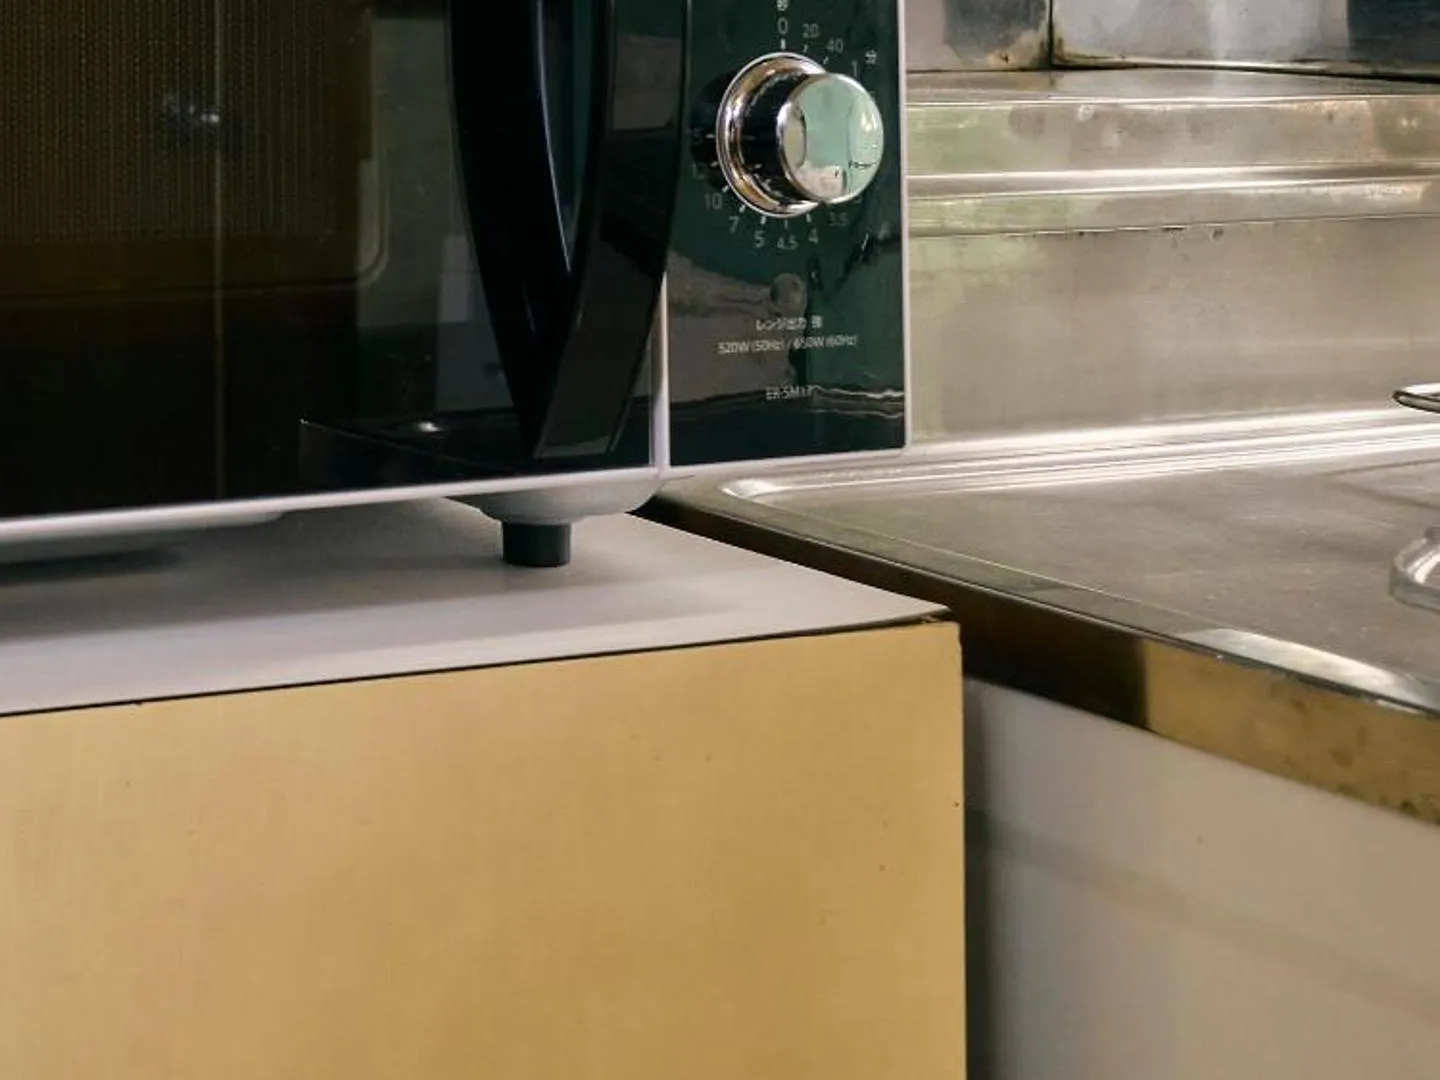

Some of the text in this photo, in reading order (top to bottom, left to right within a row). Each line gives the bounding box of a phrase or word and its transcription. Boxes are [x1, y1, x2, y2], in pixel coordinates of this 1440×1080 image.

[776, 17, 789, 35] 0
[802, 23, 820, 38] 20
[826, 38, 844, 54] 40
[704, 193, 722, 211] 10
[753, 230, 766, 247] 5
